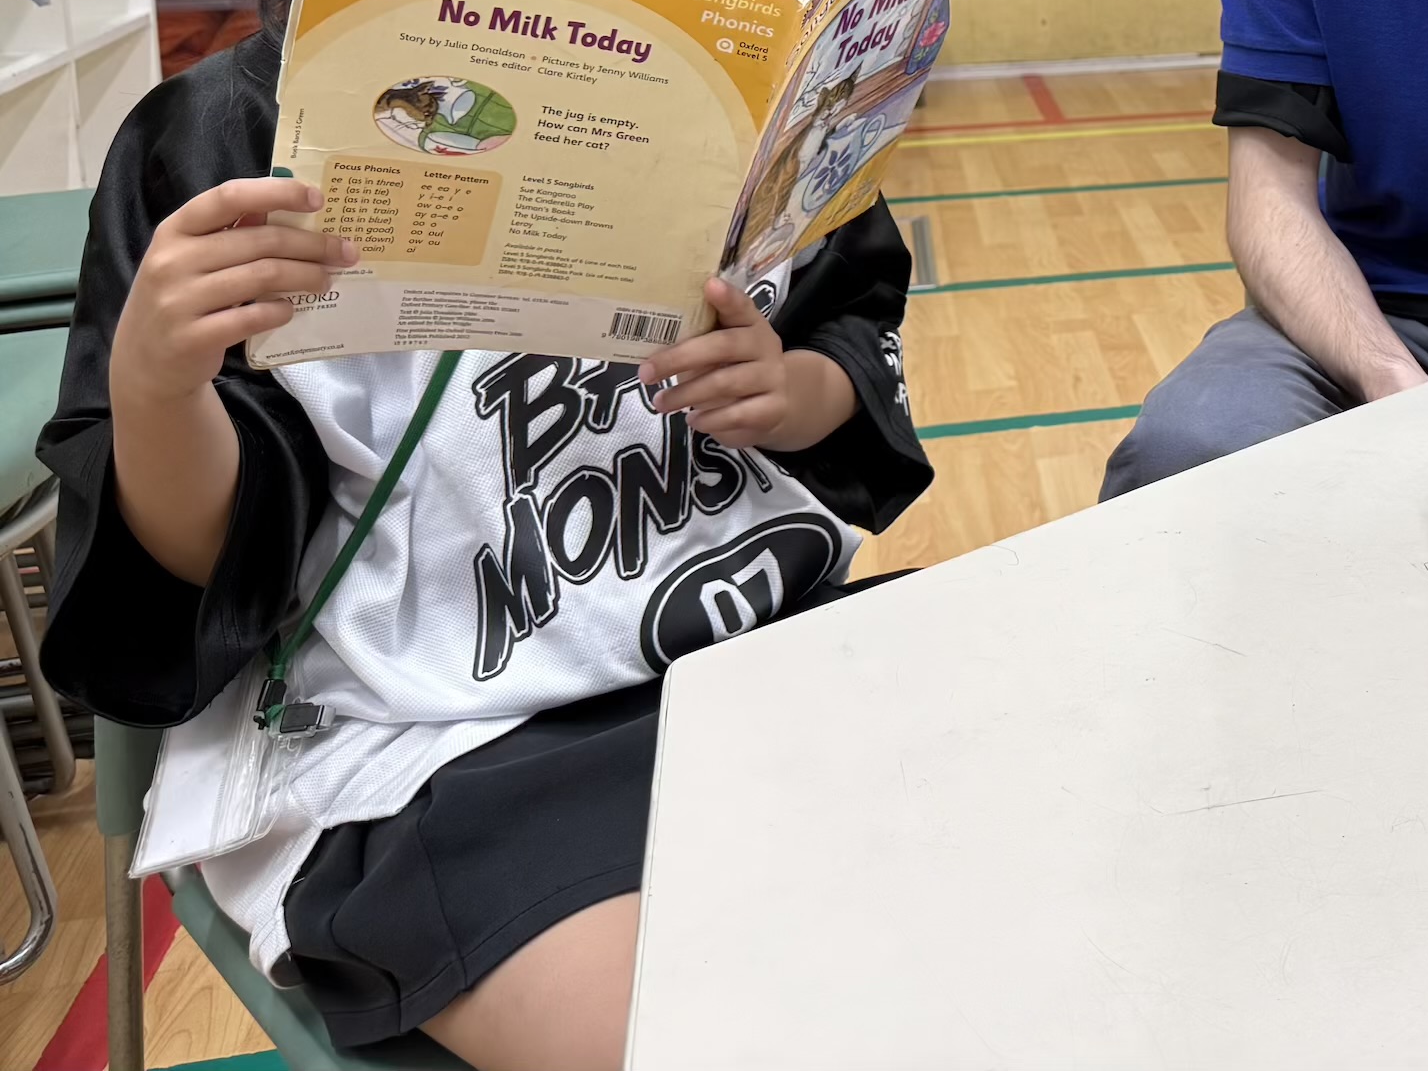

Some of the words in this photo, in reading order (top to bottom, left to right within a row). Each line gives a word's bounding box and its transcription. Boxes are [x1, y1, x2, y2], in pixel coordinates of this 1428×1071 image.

[700, 10, 775, 38] Phonics
[832, 1, 864, 41] No
[488, 7, 558, 41] Milk
[567, 20, 652, 64] Today
[739, 41, 769, 54] Oxford
[834, 17, 900, 69] Today
[400, 32, 426, 45] Story
[429, 36, 441, 48] by
[444, 39, 468, 50] Julia
[471, 43, 526, 60] Donaldson
[542, 55, 580, 70] Pictures
[582, 62, 595, 73] by
[596, 65, 626, 79] Jenny
[628, 71, 669, 85] Williams
[736, 50, 759, 61] Level
[470, 55, 499, 67] Series
[502, 61, 532, 72] editor
[537, 66, 563, 79] Clare
[566, 71, 598, 84] Kirtley
[541, 105, 563, 117] The
[564, 108, 584, 122] jug
[587, 112, 597, 122] is
[600, 117, 639, 130] empty.
[537, 119, 564, 130] How
[567, 124, 588, 133] can
[591, 127, 613, 138] Mrs
[616, 131, 650, 144] Green
[533, 132, 560, 143] feed
[563, 136, 584, 146] her
[586, 140, 610, 151] cat?
[364, 165, 400, 174] Phonics
[376, 179, 404, 188] three)
[424, 171, 452, 179] Letter
[454, 174, 489, 184] Pattern
[522, 175, 545, 184] Level
[553, 179, 595, 191] Songbirds
[520, 186, 535, 194] Sue
[536, 188, 577, 200] Kangaroo
[515, 203, 550, 213] Usman's
[551, 208, 576, 216] Books
[535, 196, 575, 207] Cinderella
[578, 201, 595, 211] Play
[340, 215, 354, 223] (as
[374, 208, 398, 216] train)
[511, 220, 533, 229] Leroy
[514, 211, 529, 219] The
[531, 213, 583, 226] Upside-down
[585, 220, 614, 230] Browns
[365, 235, 394, 244] down)
[522, 229, 540, 238] Milk
[542, 231, 567, 241] Today
[287, 291, 340, 305] XFORD
[699, 547, 787, 641] 07
